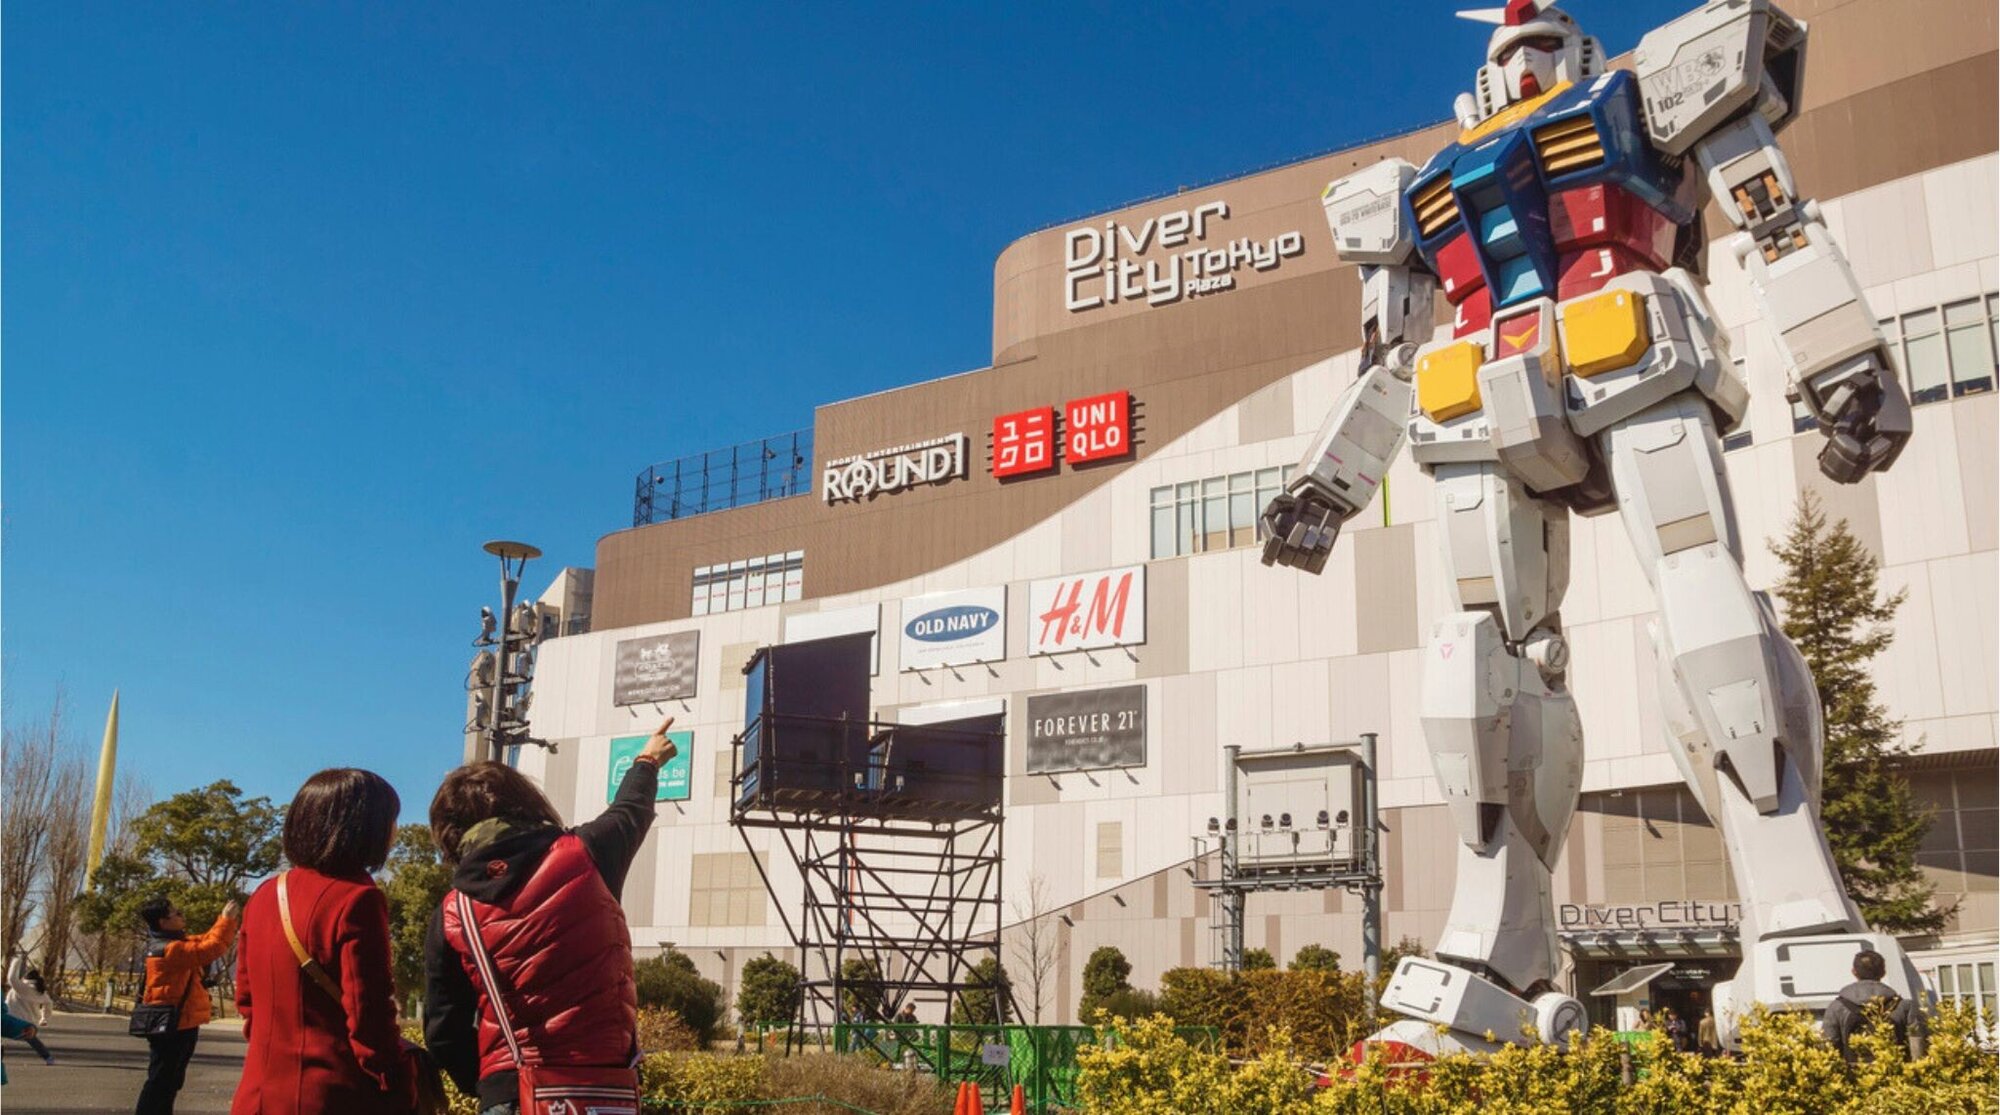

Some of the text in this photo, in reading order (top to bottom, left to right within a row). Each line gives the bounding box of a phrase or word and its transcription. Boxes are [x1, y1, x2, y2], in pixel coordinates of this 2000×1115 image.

[1657, 92, 1685, 113] 102
[1065, 200, 1227, 270] Diver
[1065, 254, 1180, 311] City
[1185, 274, 1232, 296] Plaza
[1072, 400, 1116, 428] UNI
[1000, 415, 1044, 443] ユニ
[1072, 426, 1120, 457] QLO
[1040, 572, 1132, 645] H&M
[915, 611, 989, 636] OLD NAVY
[1035, 712, 1110, 738] FOREVER
